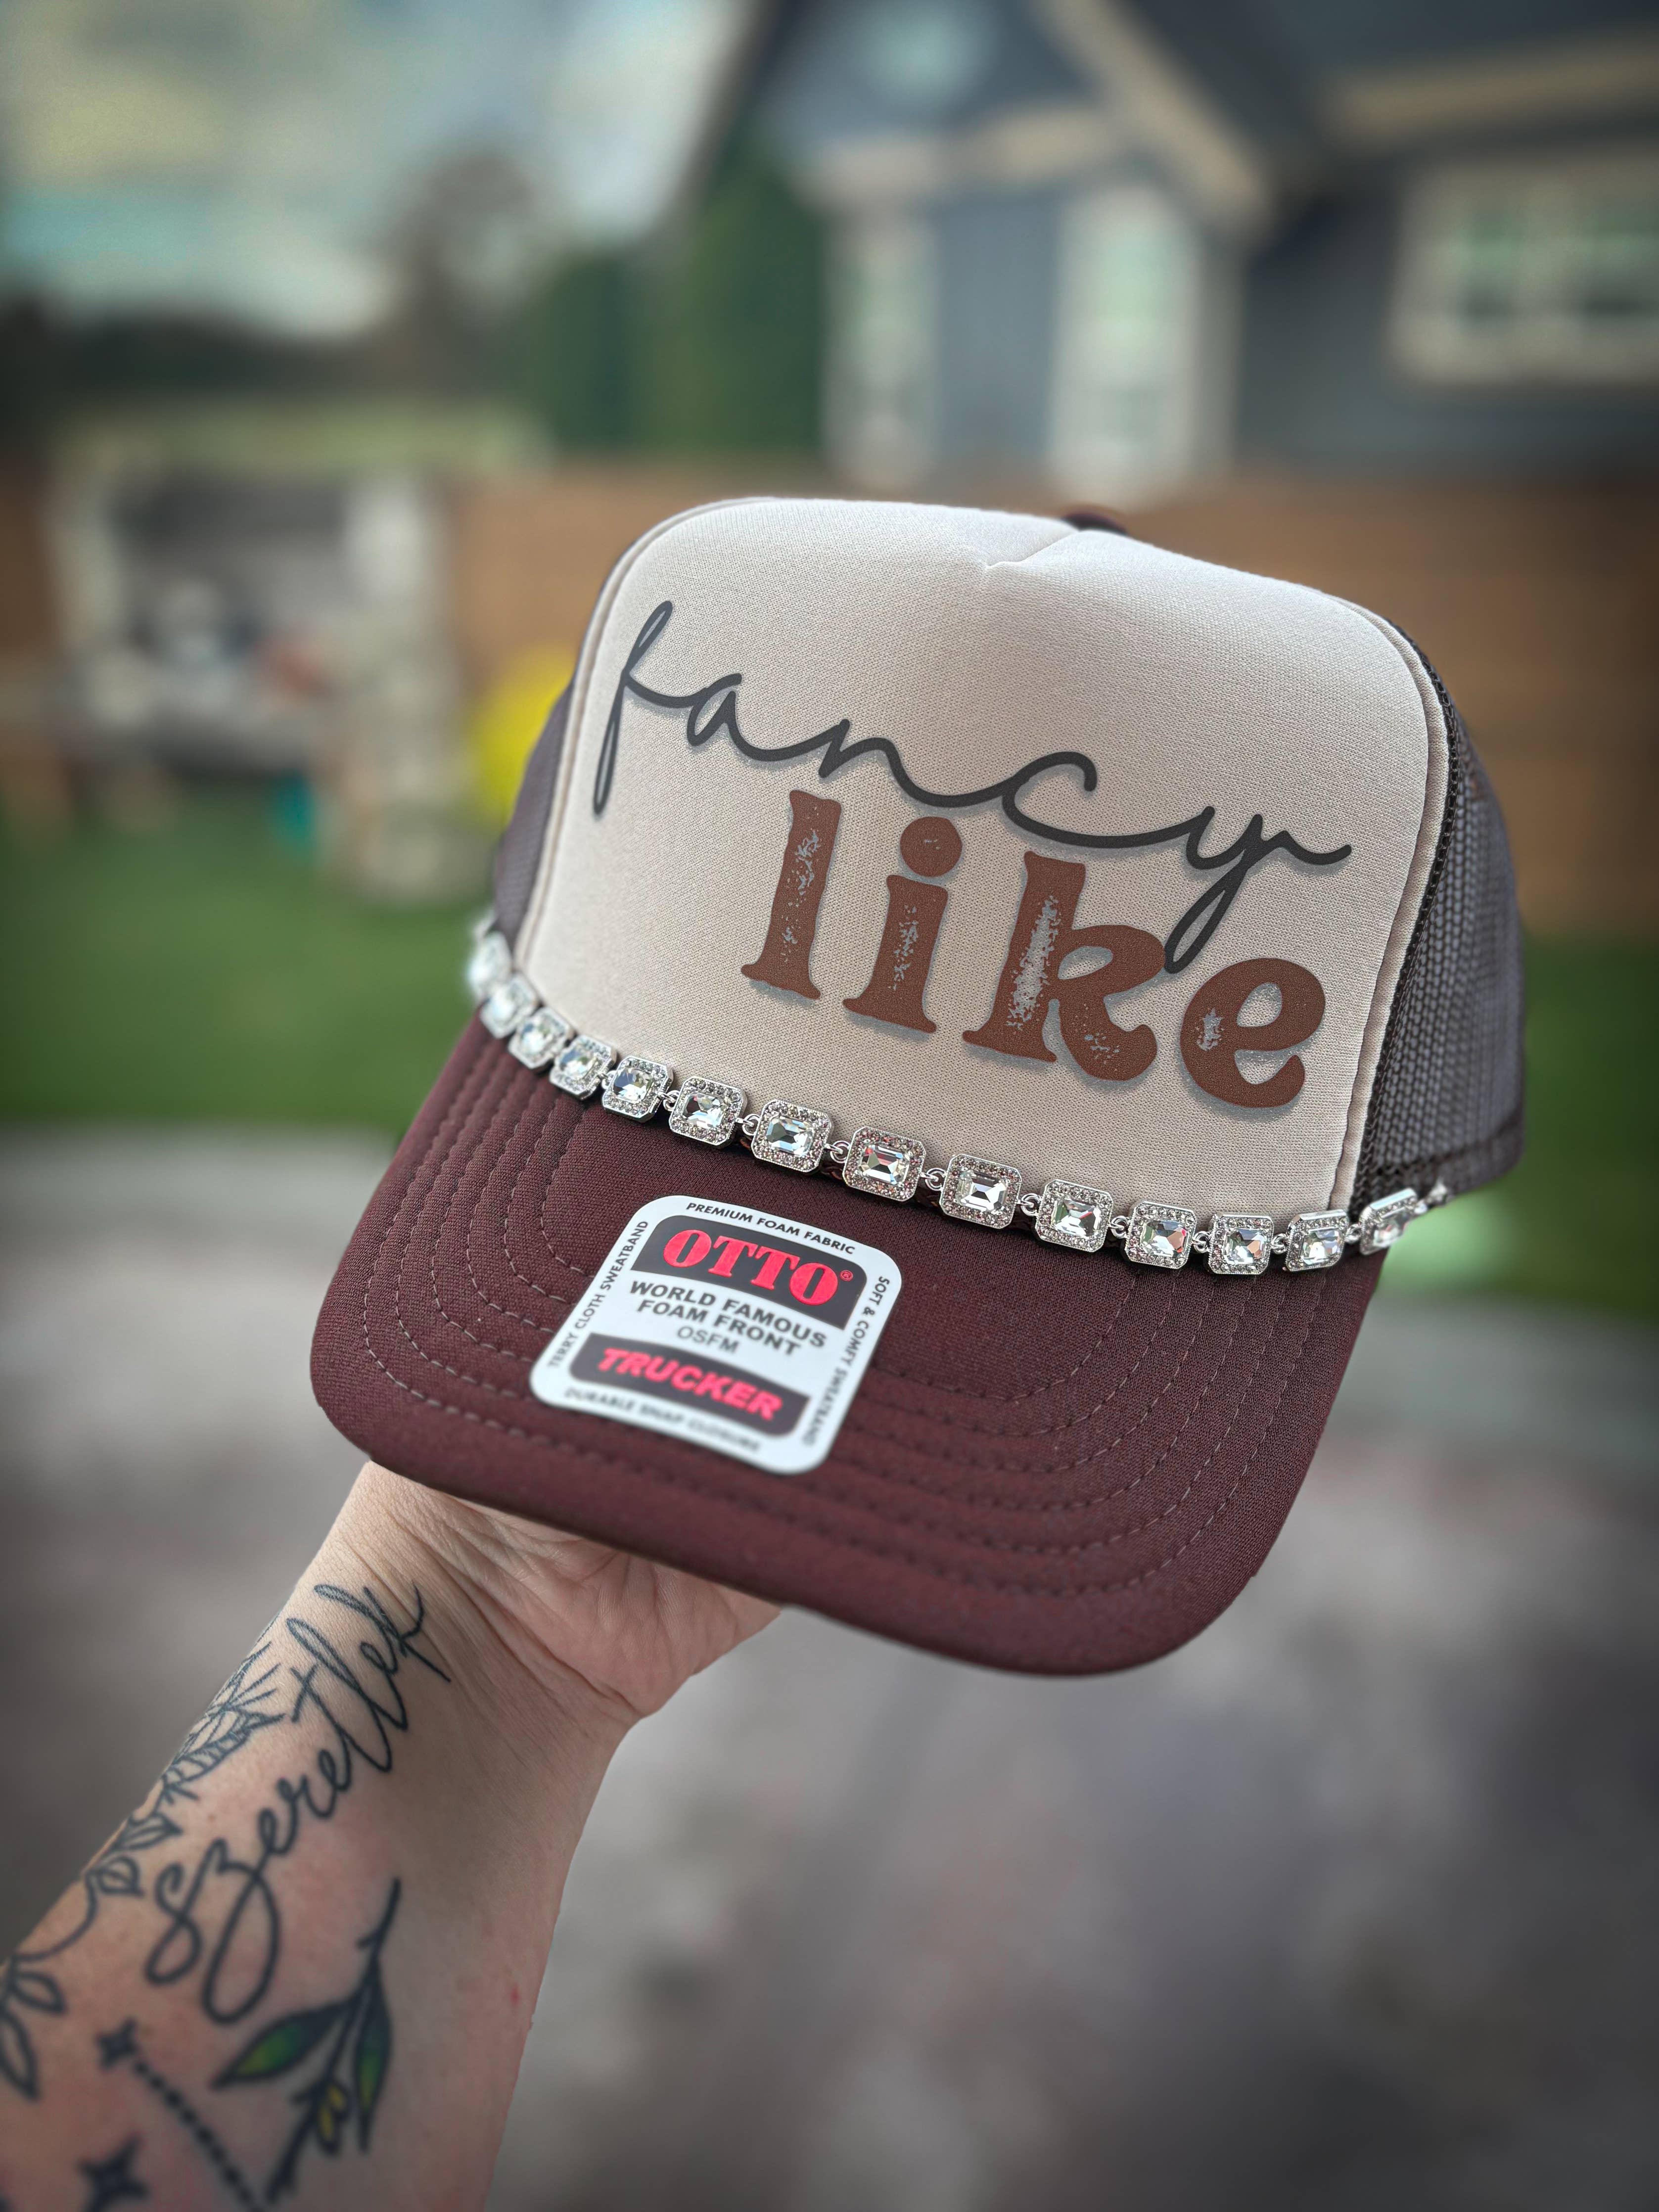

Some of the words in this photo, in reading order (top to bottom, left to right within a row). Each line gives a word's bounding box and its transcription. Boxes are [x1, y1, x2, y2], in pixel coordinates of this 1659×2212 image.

[593, 600, 1352, 973] fancy
[742, 789, 1326, 1108] like
[686, 1202, 752, 1223] PREMIUM
[756, 1217, 800, 1236] FOAM
[804, 1231, 856, 1254] FABRIC
[548, 1332, 578, 1368] TERRY
[575, 1294, 606, 1329] CLOTH
[600, 1221, 648, 1291] SWEATBAND
[630, 1281, 716, 1306] WORLD
[723, 1298, 827, 1348] FAMOUS
[862, 1306, 876, 1315] &
[869, 1276, 890, 1305] SOFT
[637, 1299, 708, 1323] FOAM
[713, 1314, 801, 1355] FRONT
[677, 1326, 739, 1354] OSFM
[841, 1320, 869, 1367] COMFY
[597, 1348, 783, 1421] TRUCKER
